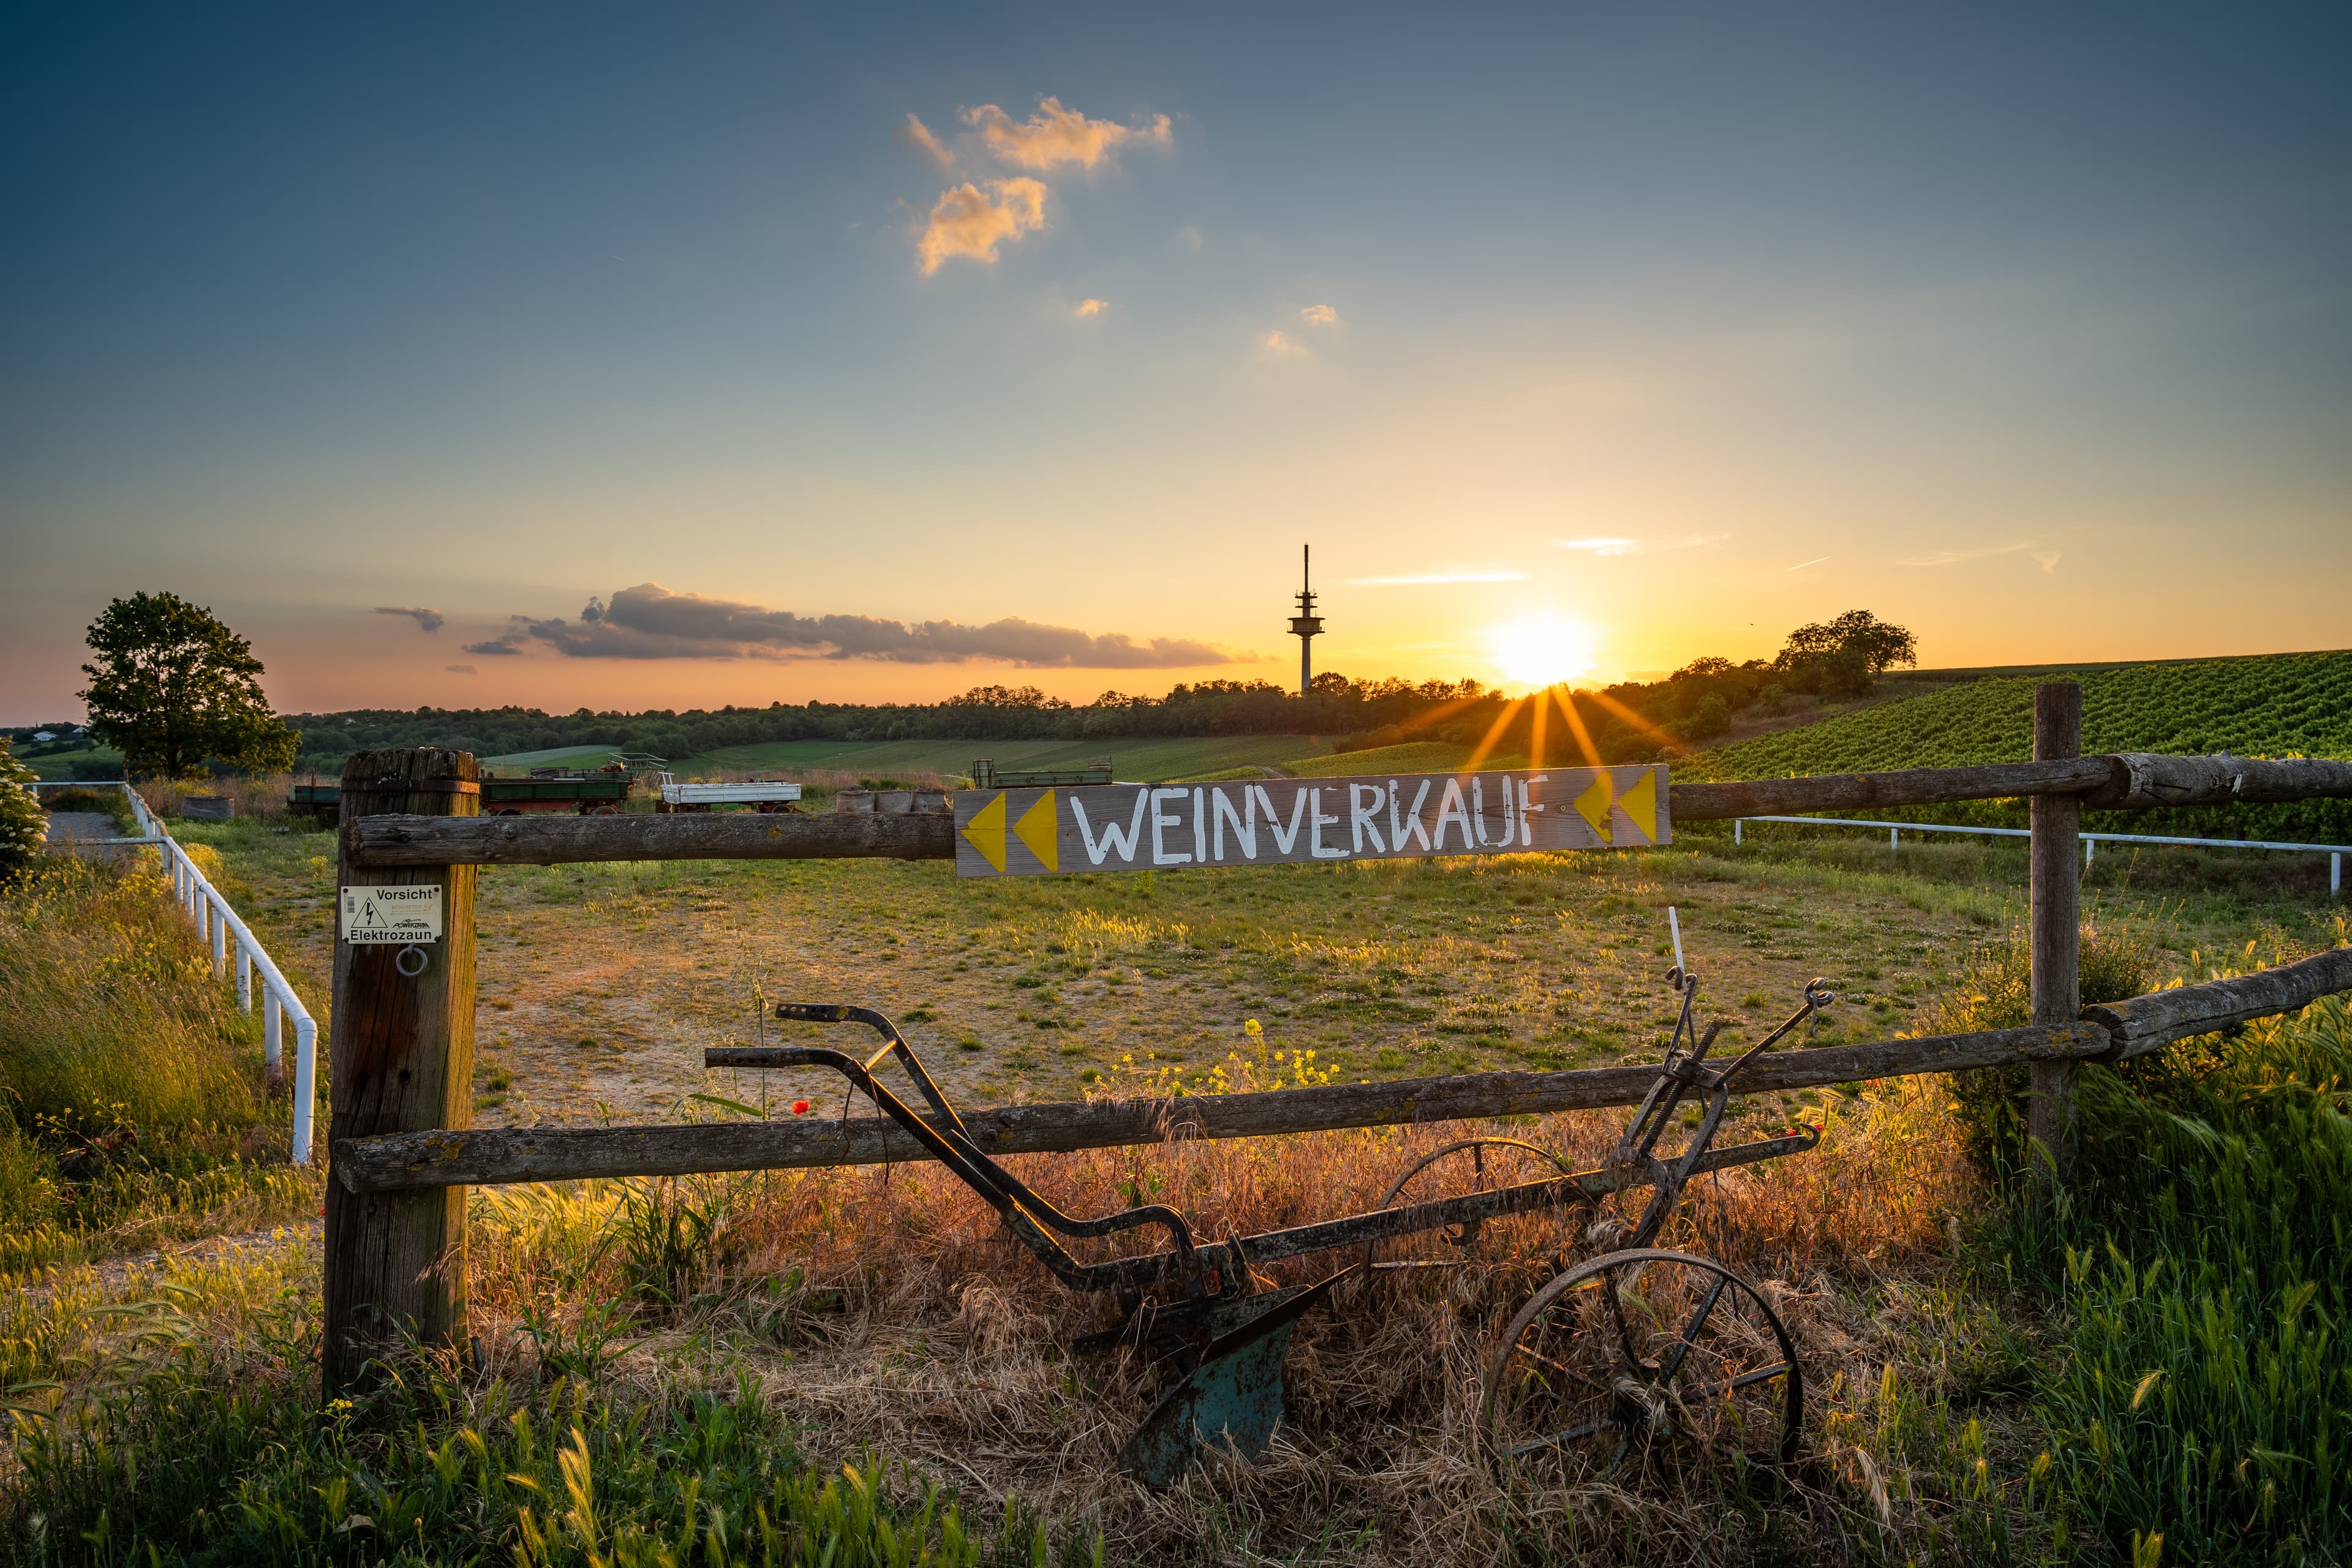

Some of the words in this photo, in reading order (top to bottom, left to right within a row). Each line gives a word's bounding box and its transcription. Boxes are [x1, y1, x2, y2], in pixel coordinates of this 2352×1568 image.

[1070, 774, 1548, 865] WEINVERKAUF
[377, 889, 432, 900] Vorsicht
[351, 930, 432, 940] Elektrozaun
